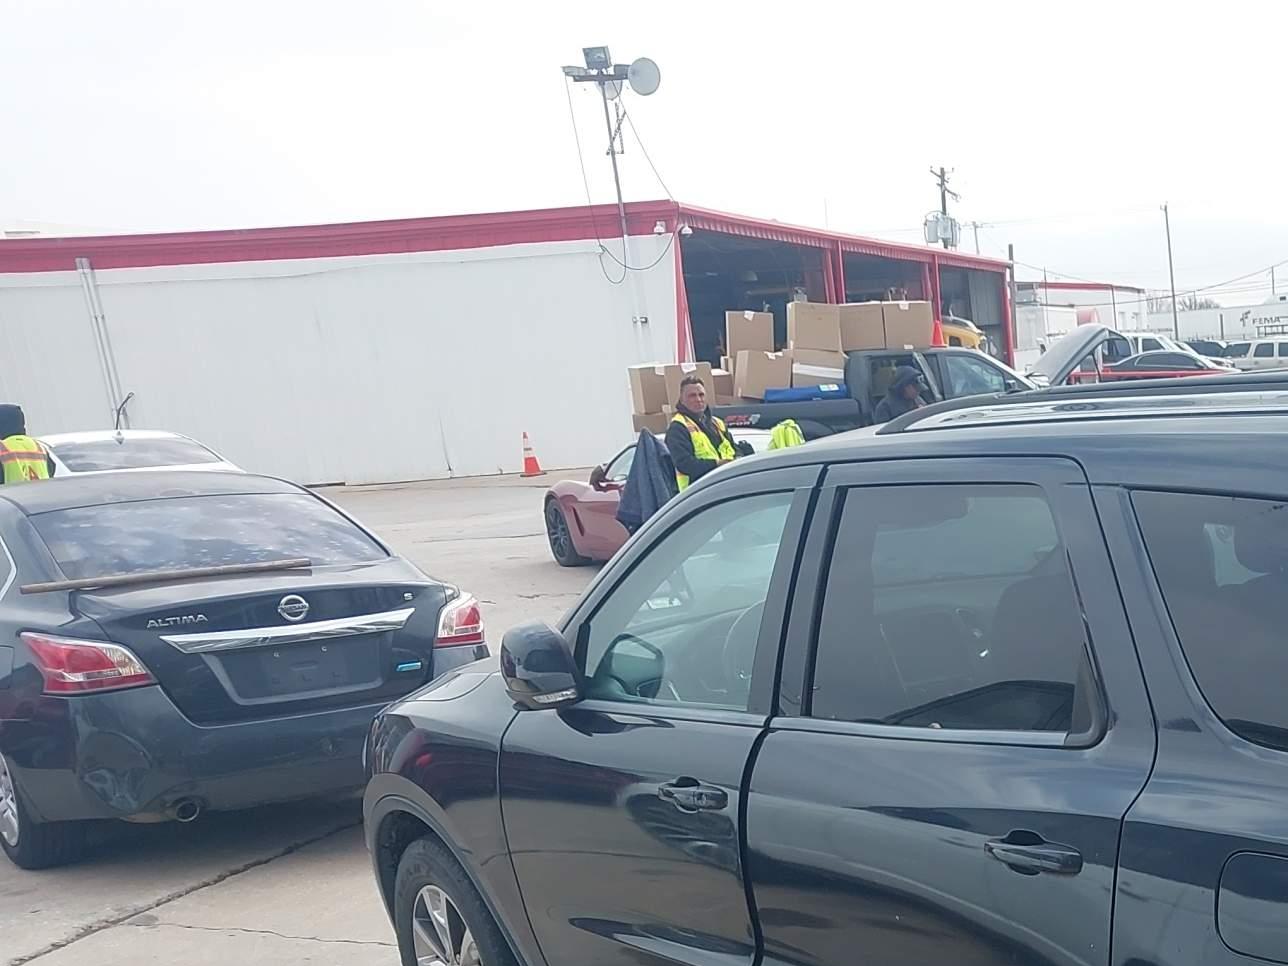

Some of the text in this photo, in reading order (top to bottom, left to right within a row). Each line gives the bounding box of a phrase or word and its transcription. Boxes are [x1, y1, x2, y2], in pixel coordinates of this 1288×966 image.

[1252, 316, 1281, 325] FEMA
[404, 592, 414, 601] S
[147, 613, 209, 629] ALTIMA
